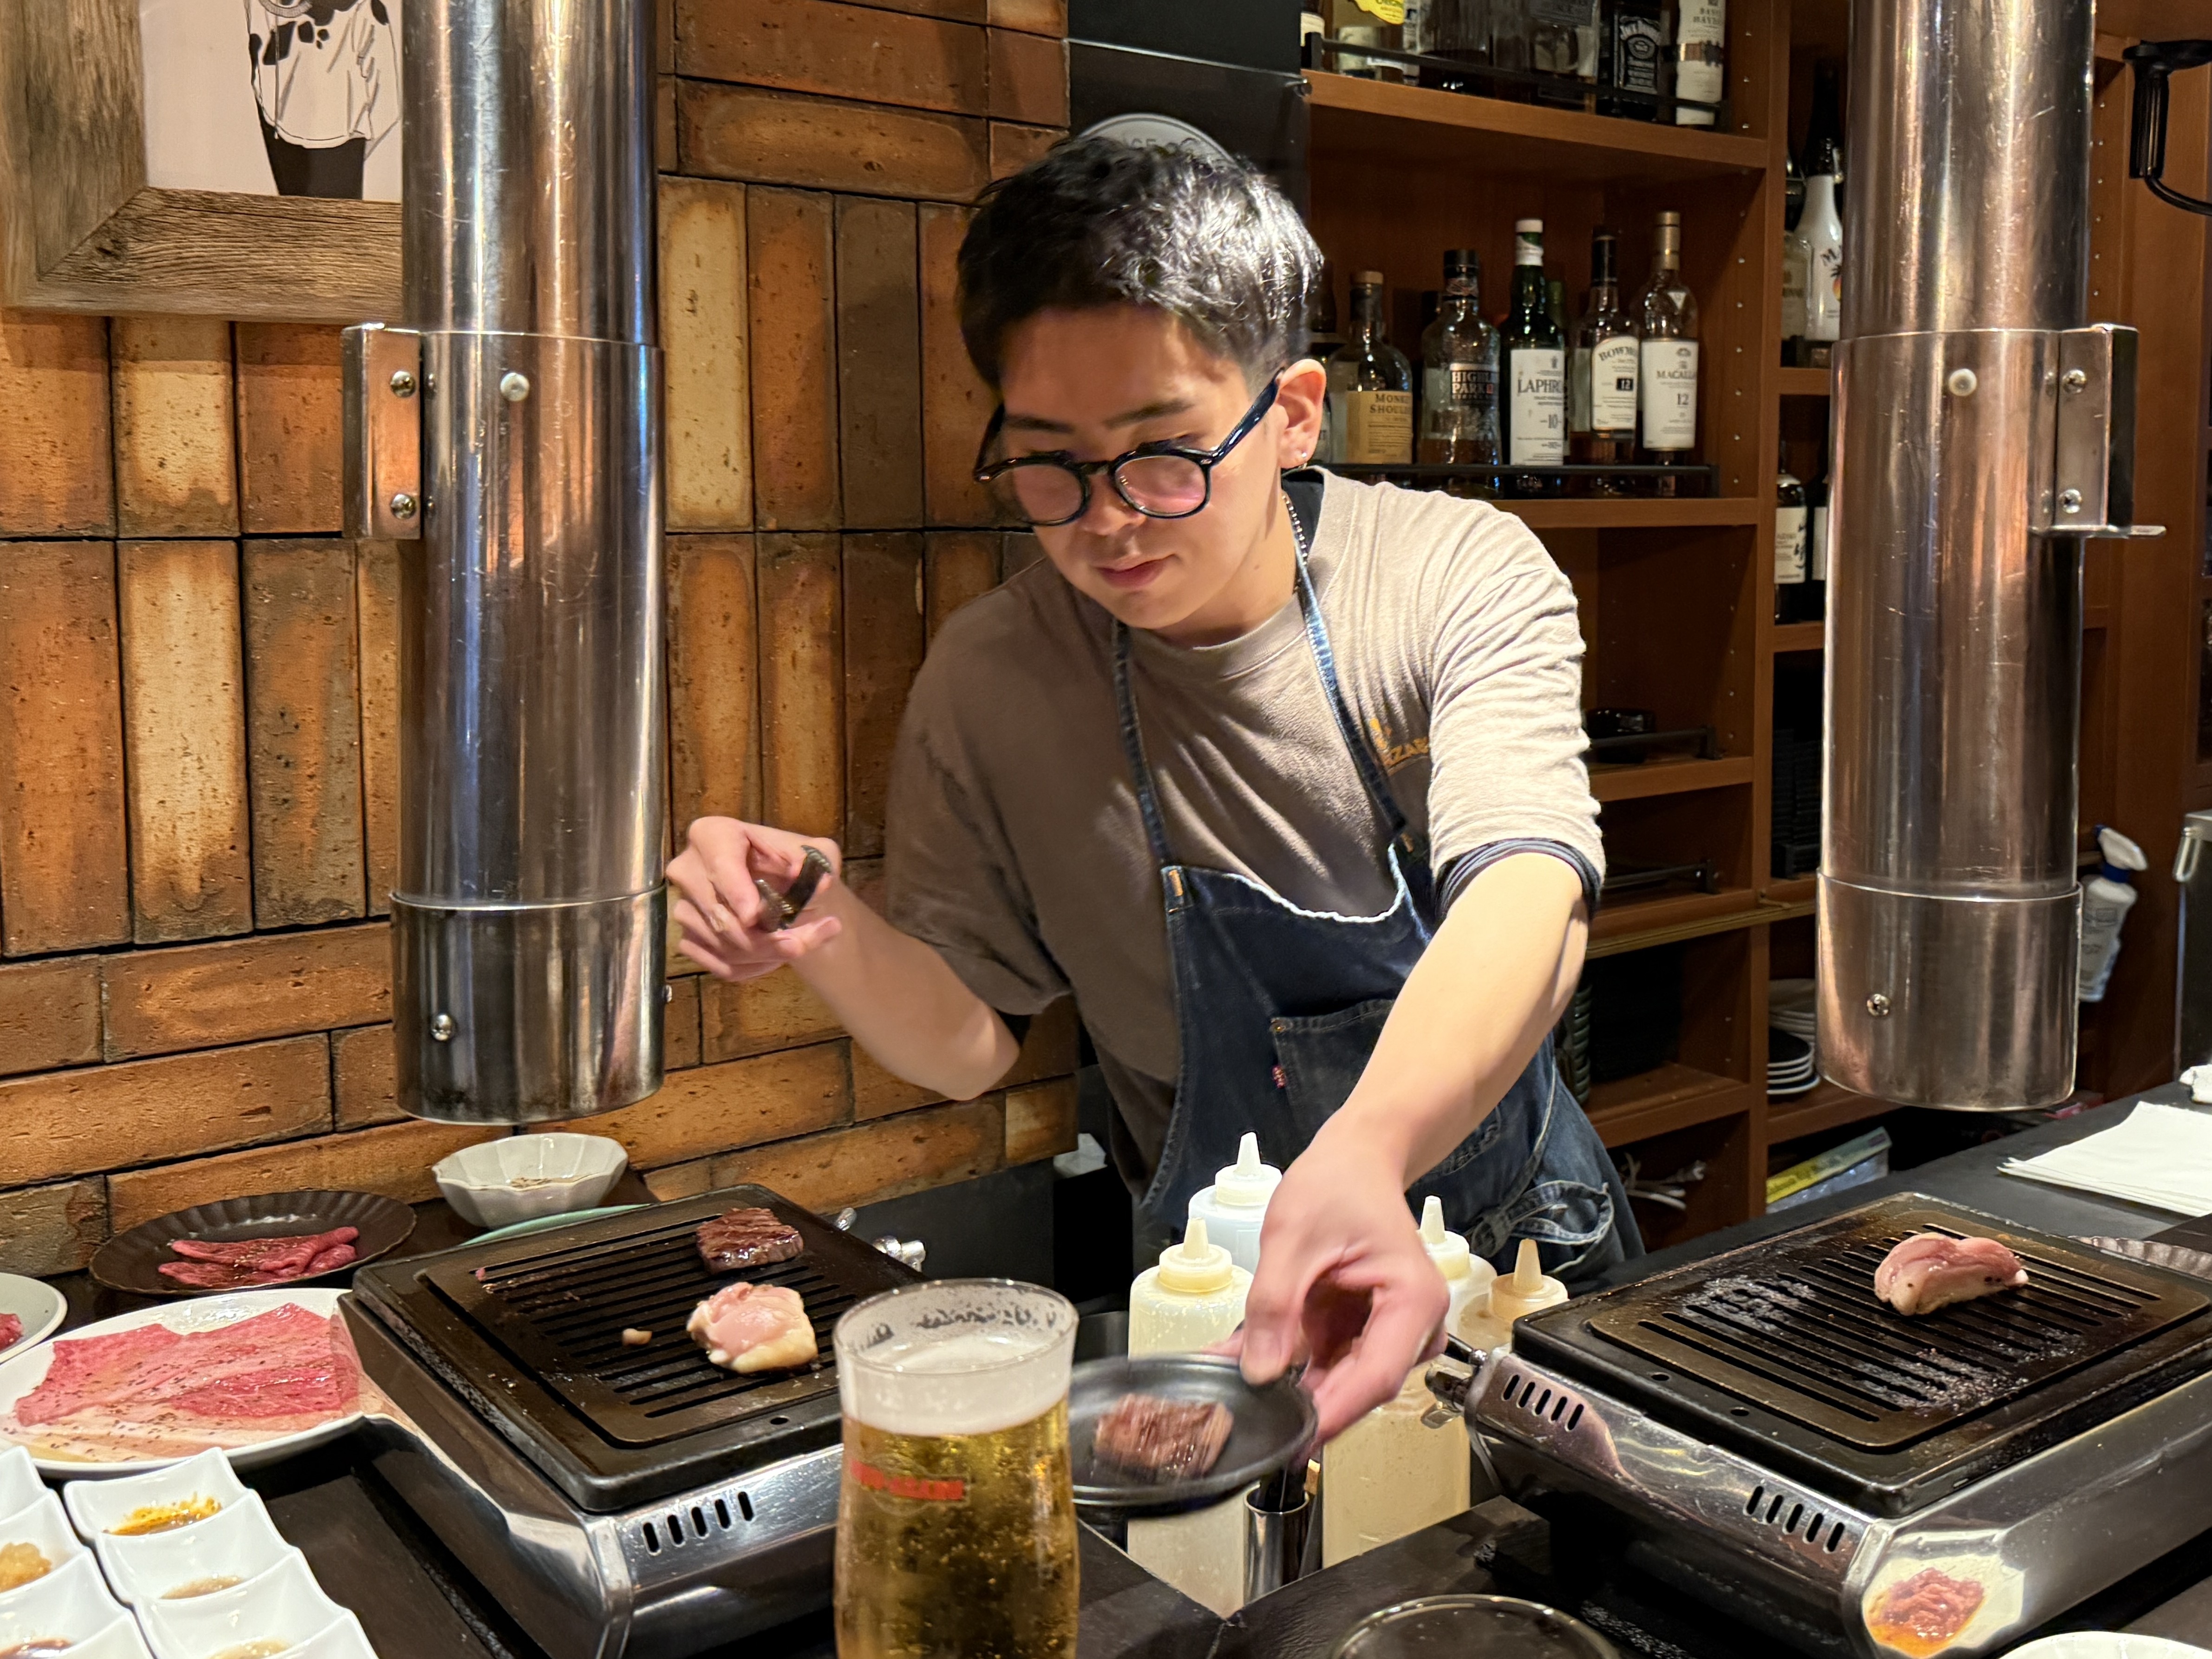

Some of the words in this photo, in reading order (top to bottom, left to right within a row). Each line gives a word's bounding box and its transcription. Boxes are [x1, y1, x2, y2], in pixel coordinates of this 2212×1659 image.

[1452, 383, 1486, 394] PARK
[1621, 379, 1630, 389] 12
[1677, 393, 1689, 405] 12
